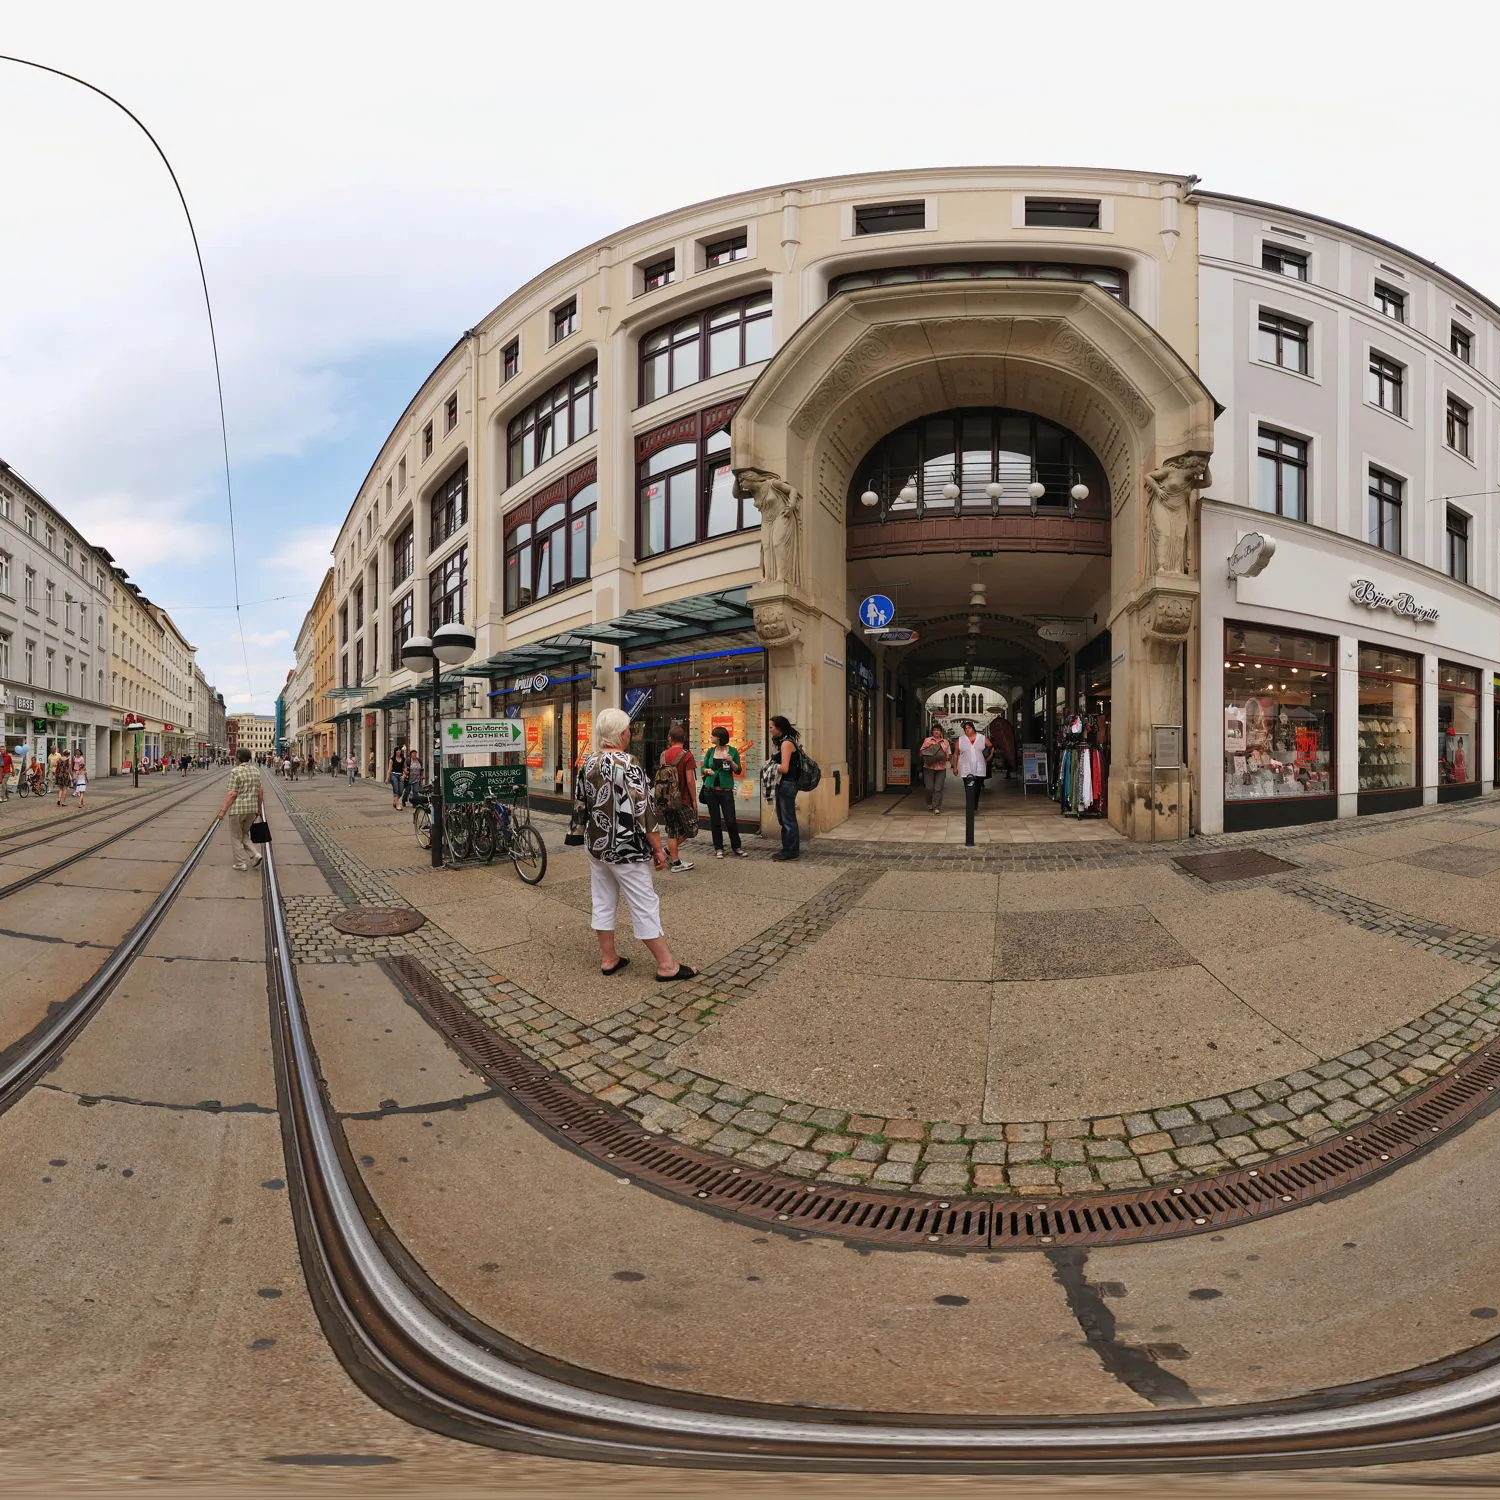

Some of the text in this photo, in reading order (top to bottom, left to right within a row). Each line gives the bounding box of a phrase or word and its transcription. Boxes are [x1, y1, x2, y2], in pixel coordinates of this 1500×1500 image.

[1353, 579, 1441, 621] Bijou Brigitte
[18, 698, 33, 710] BASE
[480, 769, 521, 778] STRASSBURG
